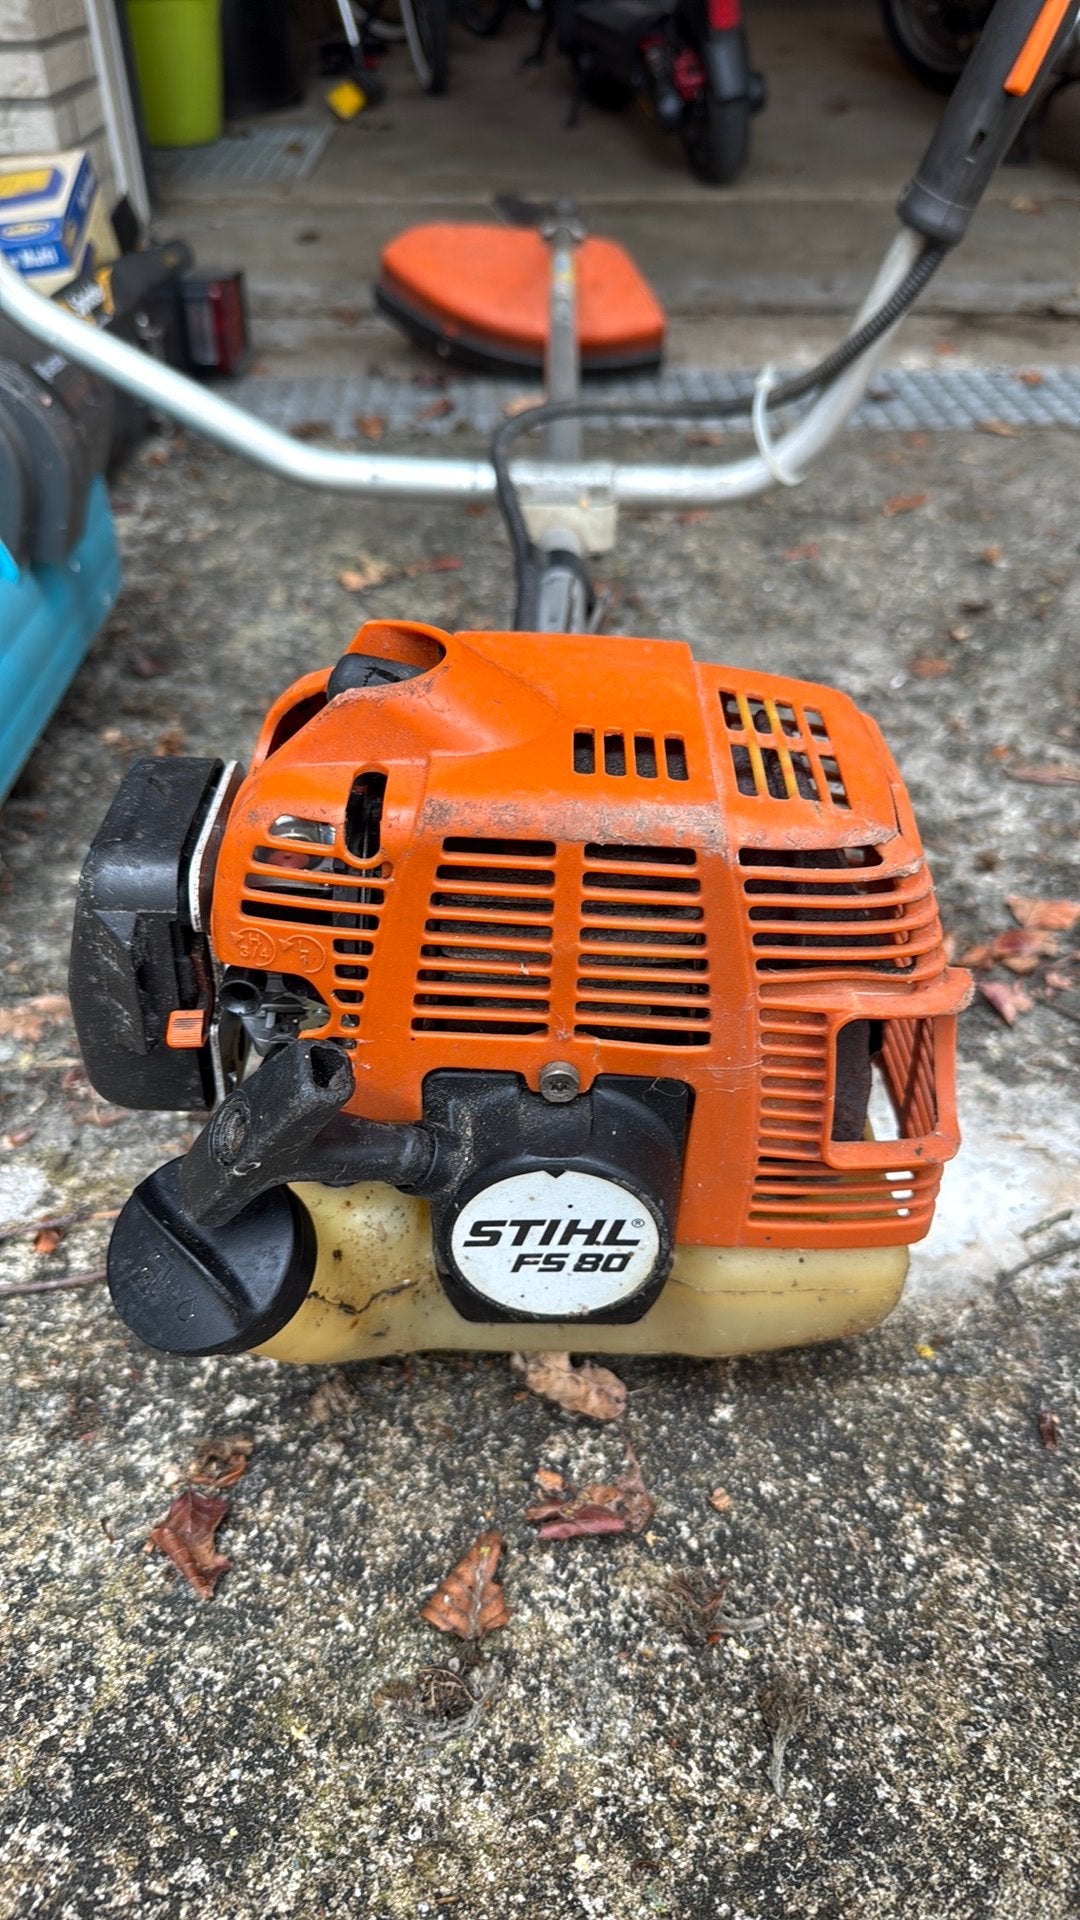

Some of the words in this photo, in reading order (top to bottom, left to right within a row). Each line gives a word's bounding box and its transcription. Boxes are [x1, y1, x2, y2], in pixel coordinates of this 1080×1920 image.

[239, 944, 270, 959] 3/4
[510, 1253, 571, 1273] FS
[572, 1253, 633, 1273] 80
